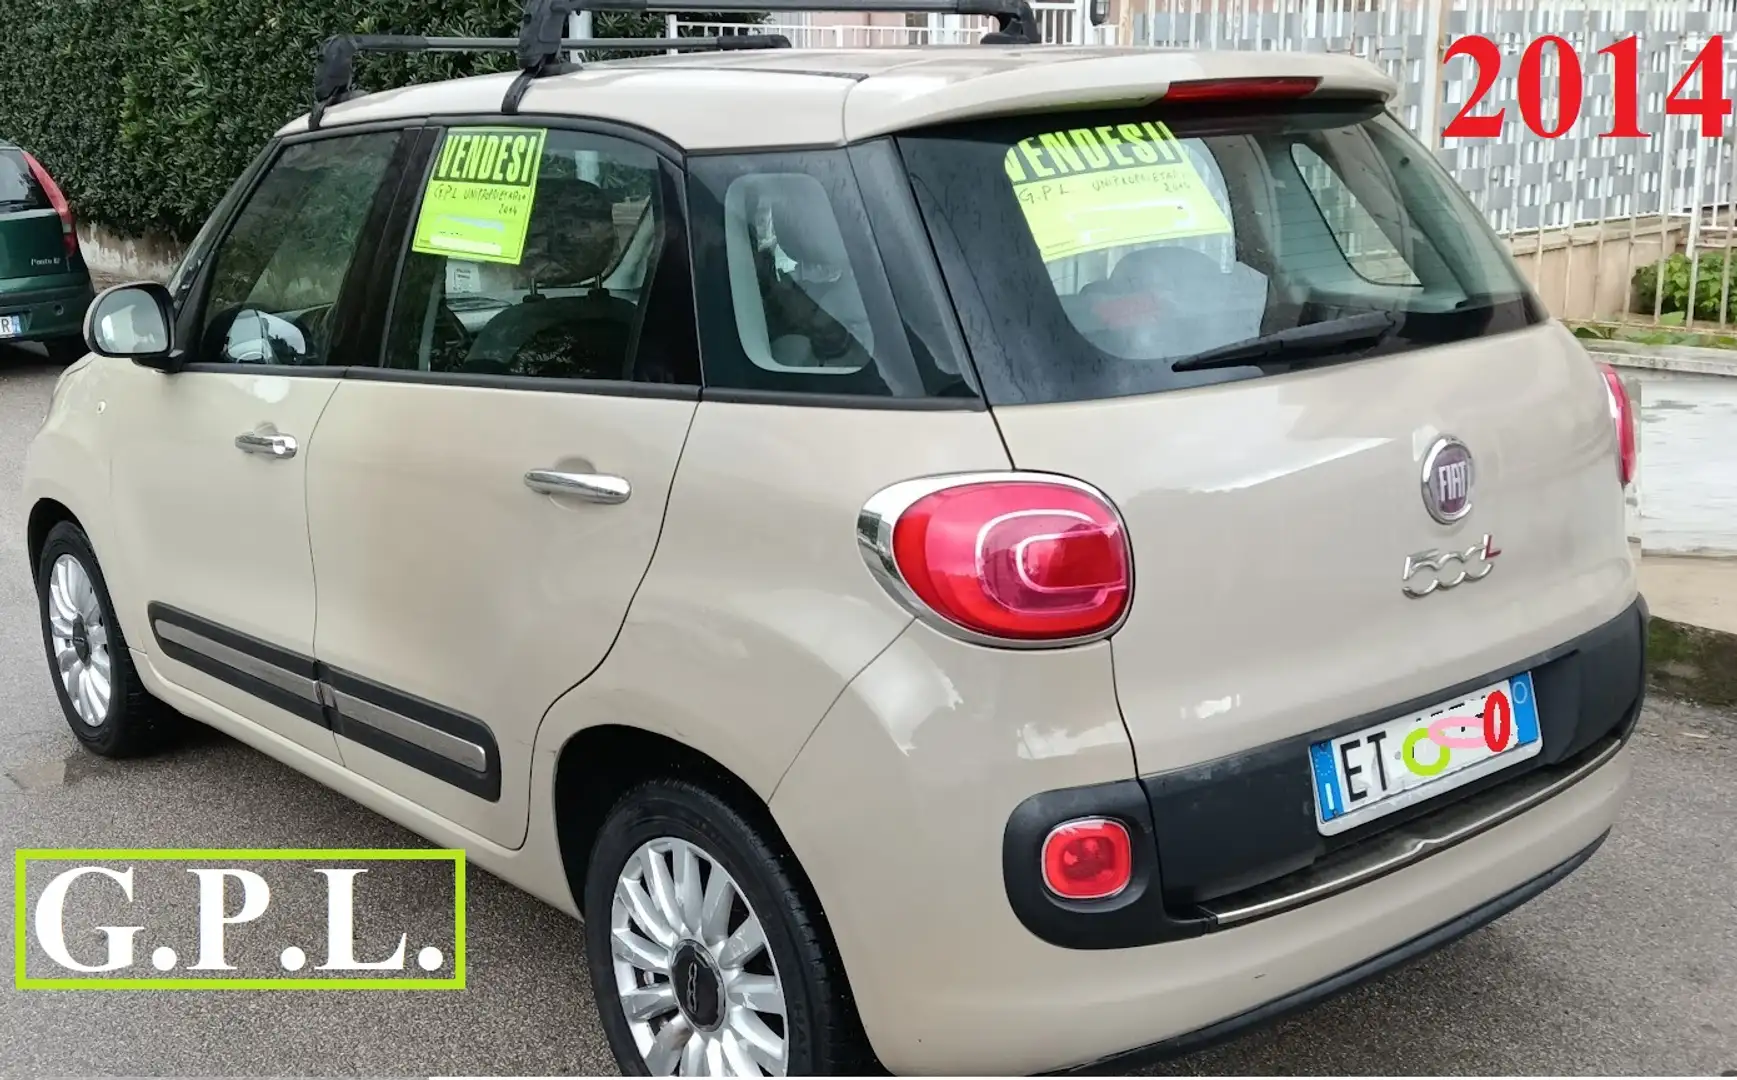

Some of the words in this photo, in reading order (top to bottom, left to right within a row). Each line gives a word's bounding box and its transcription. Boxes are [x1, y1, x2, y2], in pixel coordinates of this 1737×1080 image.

[438, 134, 537, 182] VENDESI
[1438, 461, 1467, 502] FIAT
[1340, 731, 1387, 802] ET
